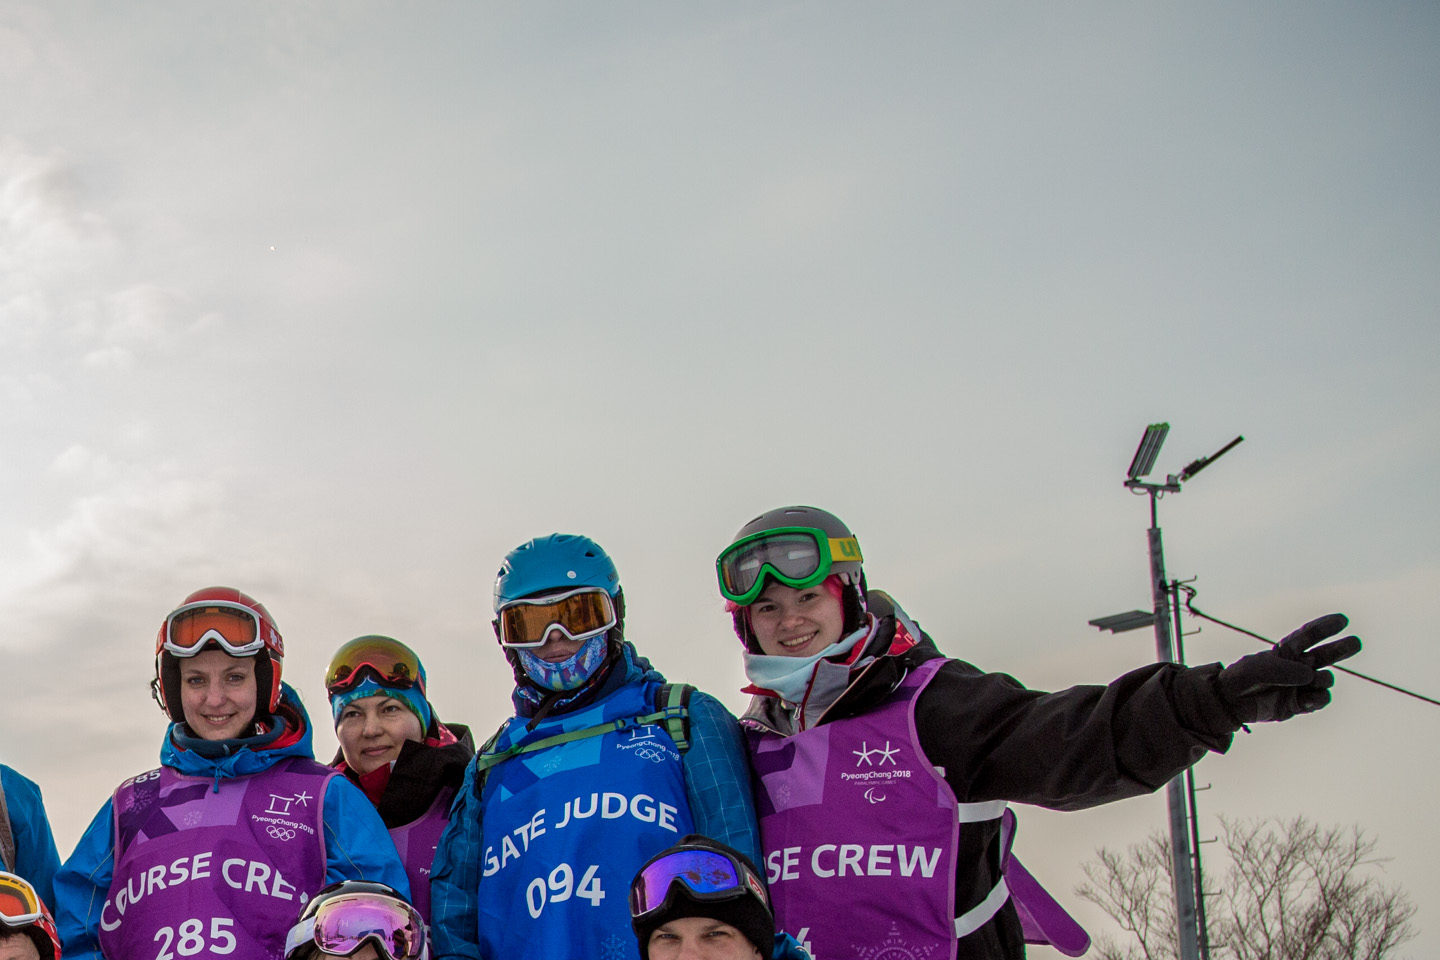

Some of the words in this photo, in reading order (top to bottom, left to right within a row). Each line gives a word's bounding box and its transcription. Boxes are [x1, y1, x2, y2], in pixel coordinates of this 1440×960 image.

[122, 769, 161, 789] 285
[841, 771, 892, 781] PyeongChang
[892, 770, 911, 778] 2018
[251, 814, 299, 830] PyeongChang
[298, 822, 314, 835] 2018
[482, 808, 546, 877] GATE
[555, 792, 678, 833] JUDGE
[221, 858, 308, 903] CRE
[764, 846, 801, 885] SE
[811, 844, 943, 878] CREW
[525, 862, 606, 919] 094
